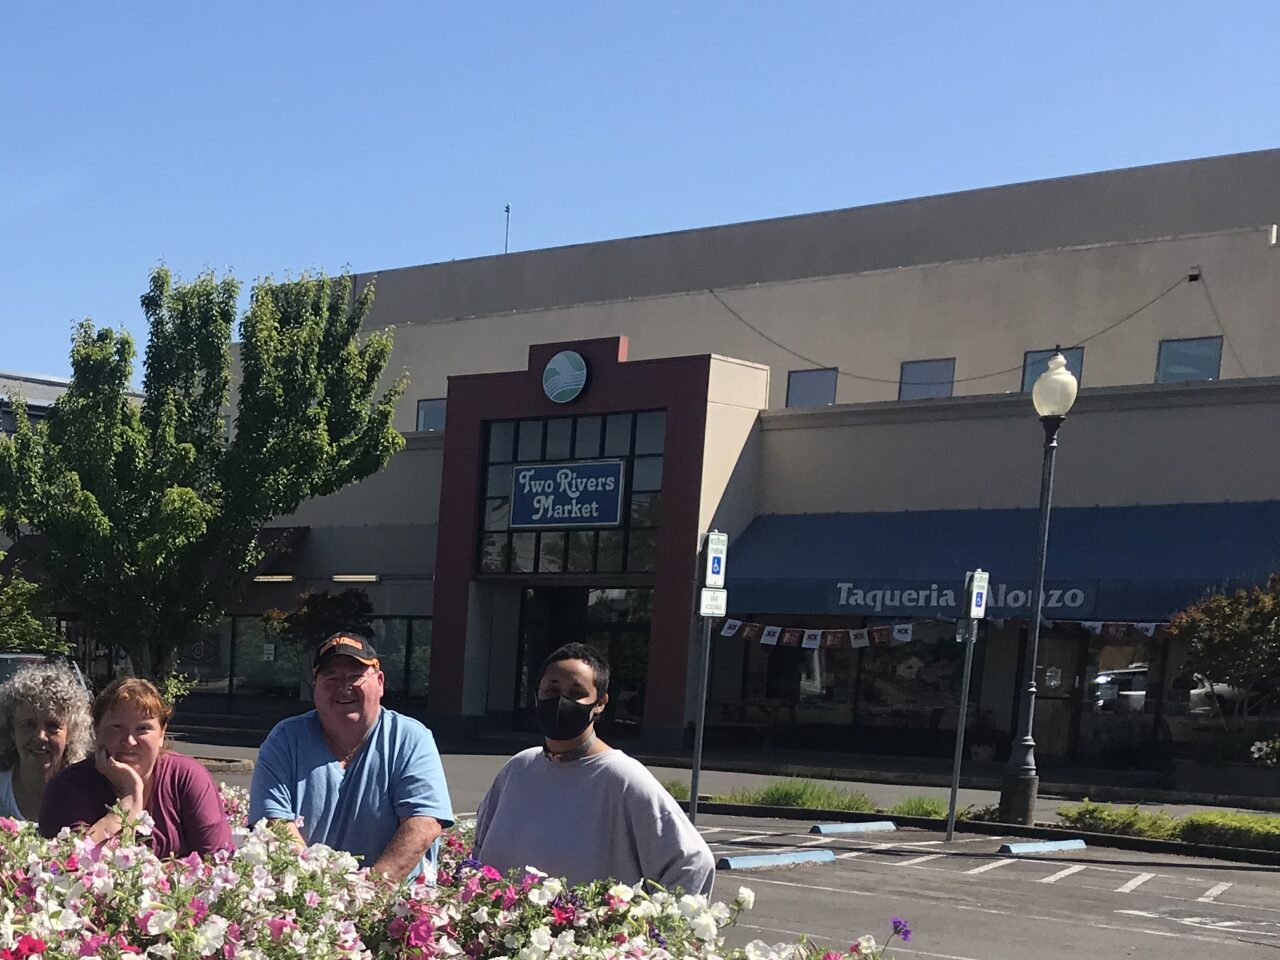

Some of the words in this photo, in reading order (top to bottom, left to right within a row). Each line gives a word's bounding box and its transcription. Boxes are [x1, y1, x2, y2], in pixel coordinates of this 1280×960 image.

[519, 469, 555, 494] Two
[557, 468, 615, 498] Rivers
[532, 495, 599, 520] Market
[837, 582, 956, 612] Taqueria
